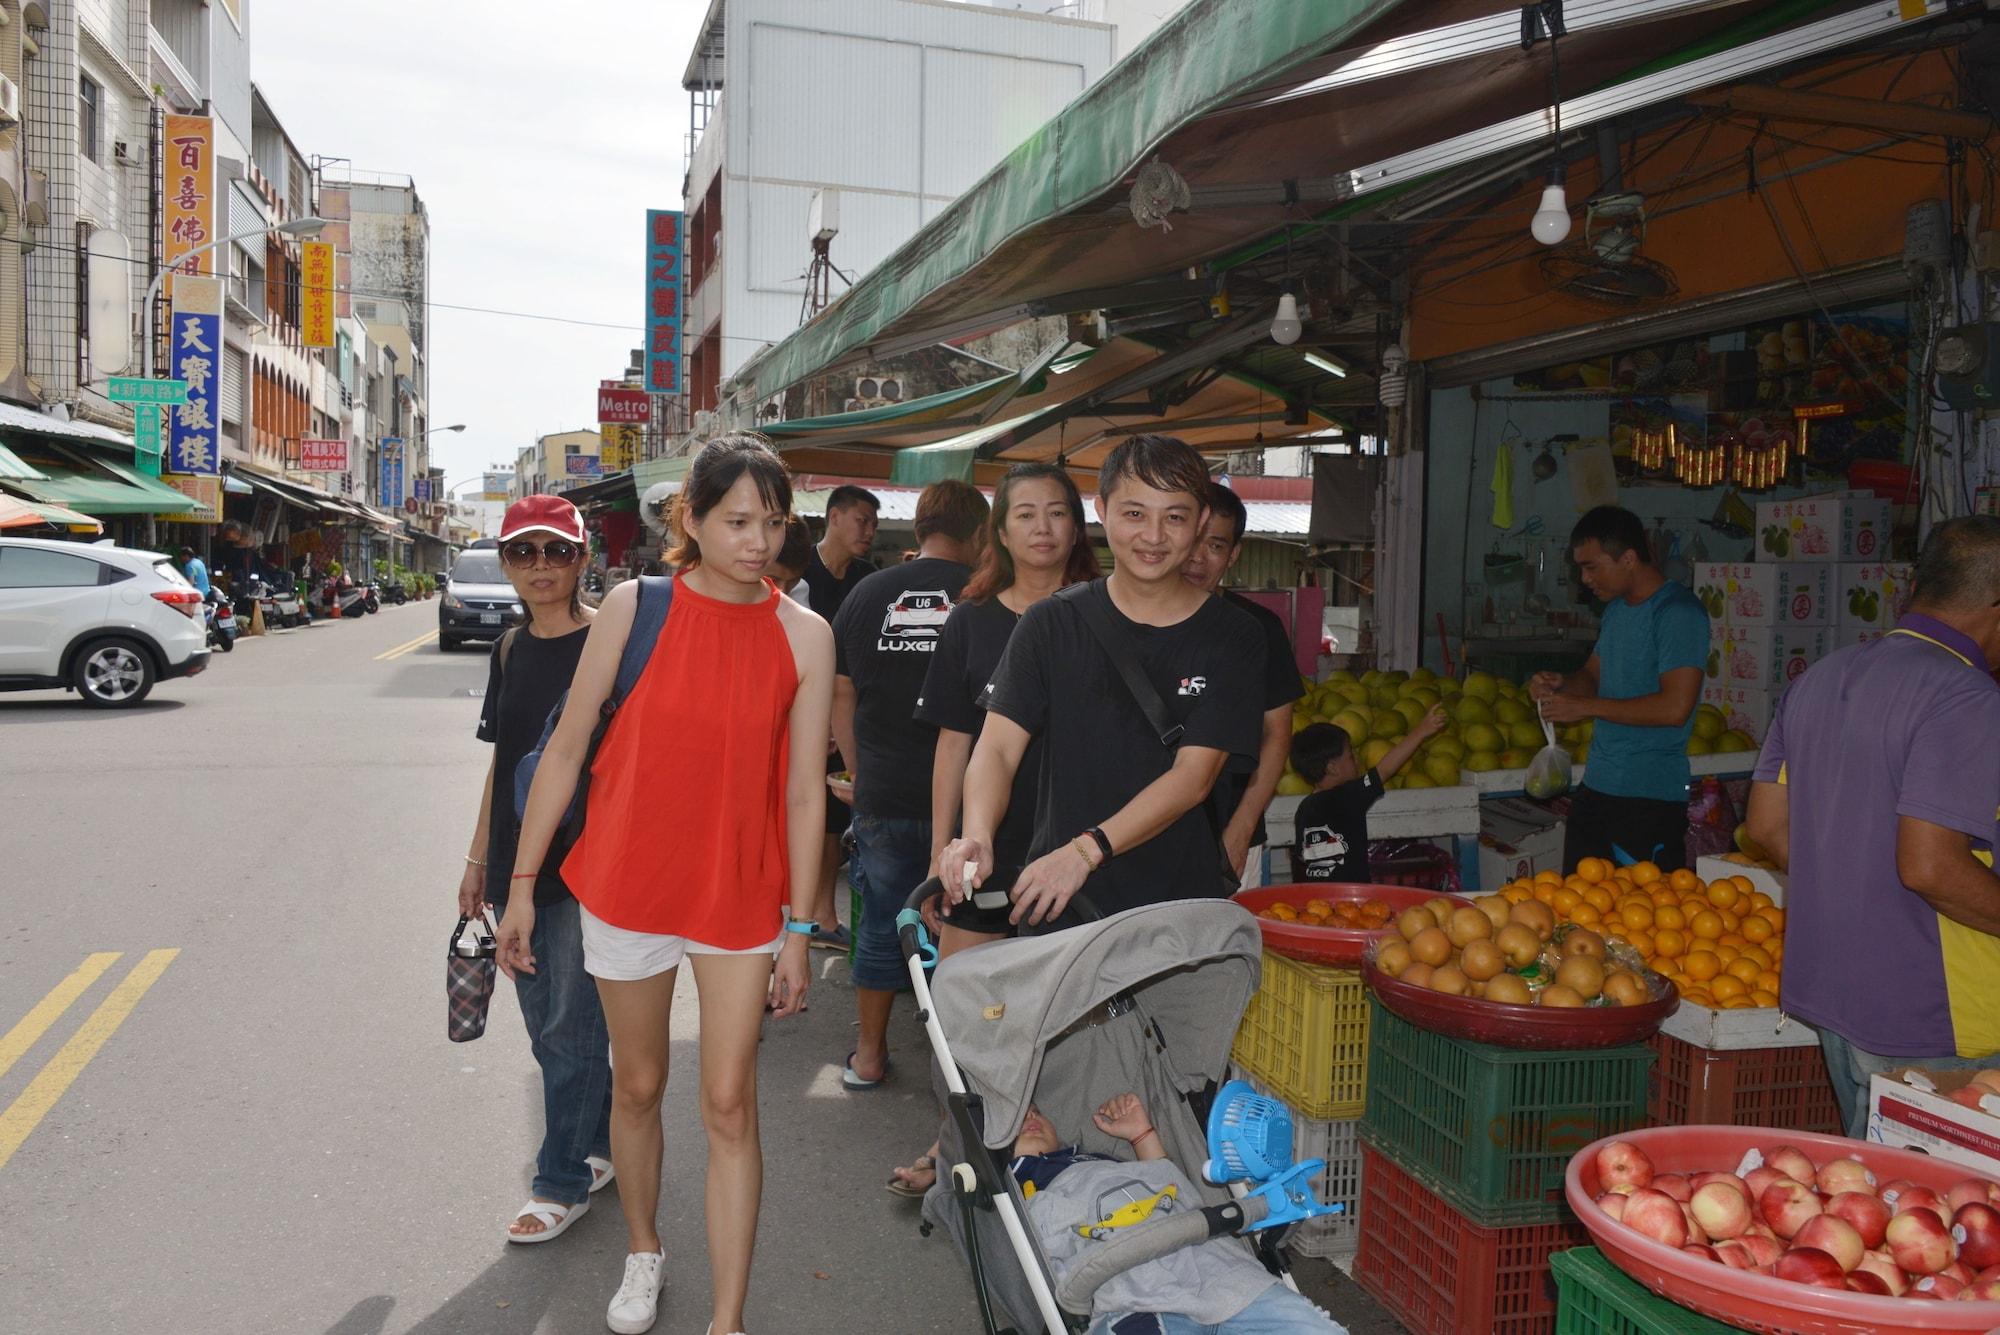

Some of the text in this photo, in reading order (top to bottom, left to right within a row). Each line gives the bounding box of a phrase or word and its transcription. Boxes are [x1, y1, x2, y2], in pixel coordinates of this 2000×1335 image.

[308, 245, 328, 343] 南無觀世音菩薩
[122, 382, 172, 400] 新興路
[176, 317, 215, 471] 天寶銀樓
[600, 397, 647, 413] Metro
[915, 598, 931, 608] U6
[1908, 1112, 1939, 1128] PREMIUM
[1940, 1123, 1980, 1143] NORTHWEST
